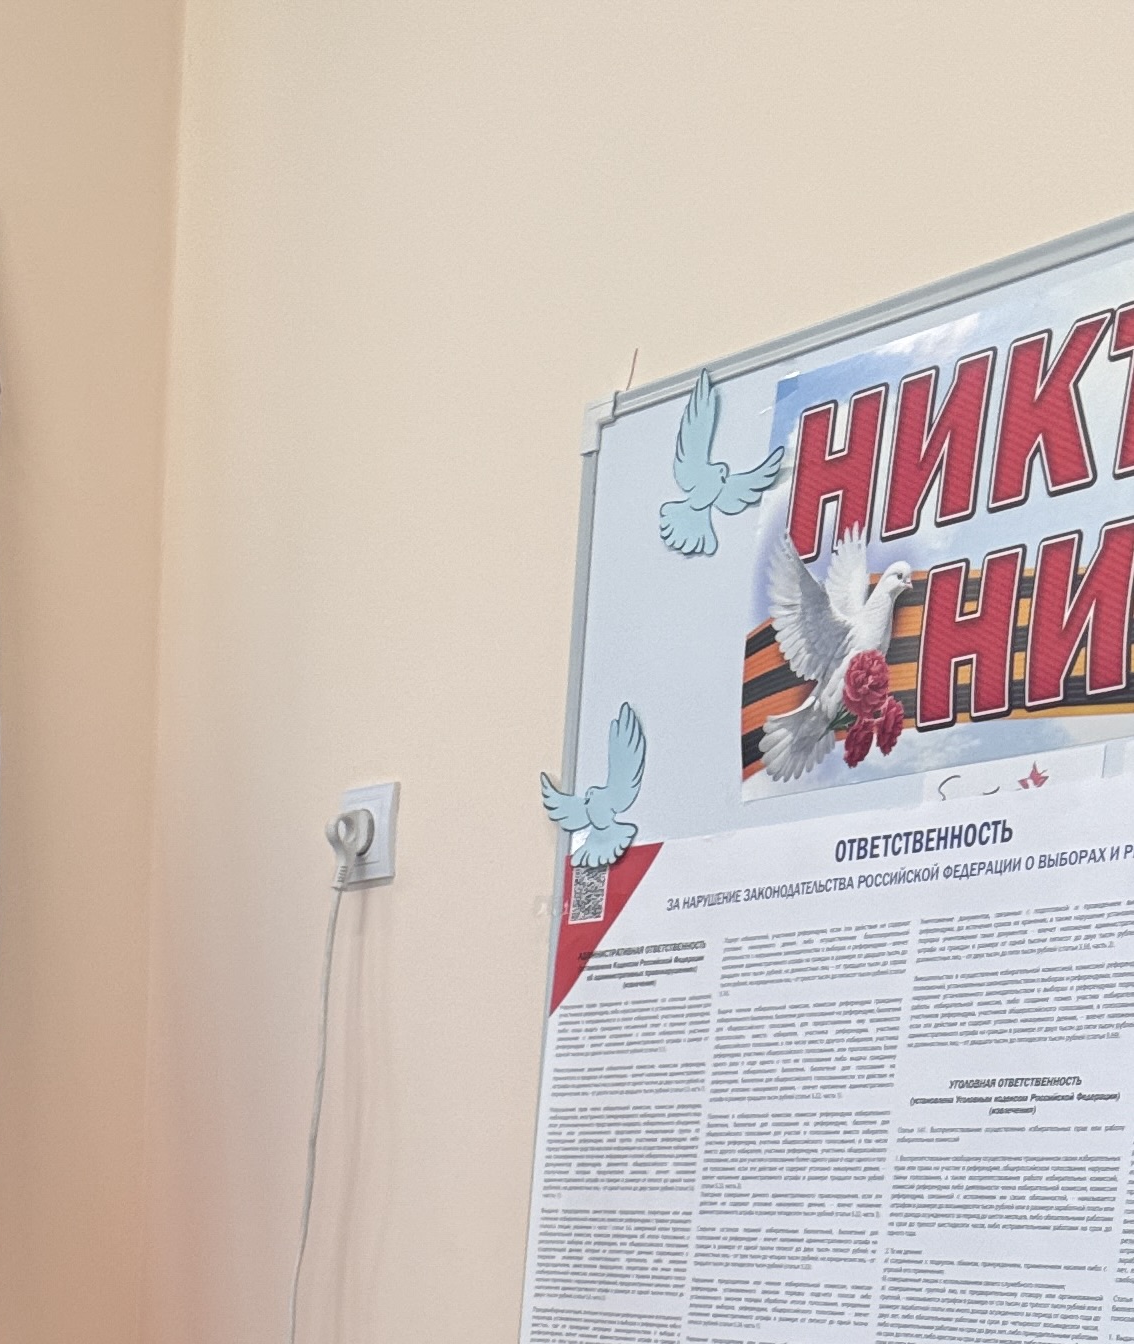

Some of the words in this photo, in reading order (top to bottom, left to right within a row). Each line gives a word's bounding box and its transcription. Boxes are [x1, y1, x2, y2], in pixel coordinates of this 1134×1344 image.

[834, 819, 1014, 863] ОТВЕТСТВЕННОСТЬ
[666, 897, 681, 911] ЗА
[681, 889, 742, 910] НАРУШЕНИЕ
[743, 876, 854, 902] ЗАКОНОДАТЕЛЬСТВА
[857, 862, 940, 888] РОССИЙСКОЙ
[942, 855, 1022, 881] ФЕДЕРАЦИИ
[1024, 855, 1035, 871] О
[1037, 846, 1107, 870] ВЫБОРАХ
[1109, 845, 1121, 862] И
[997, 1075, 1083, 1088] ОТВЕТСТВЕННОСТЬ
